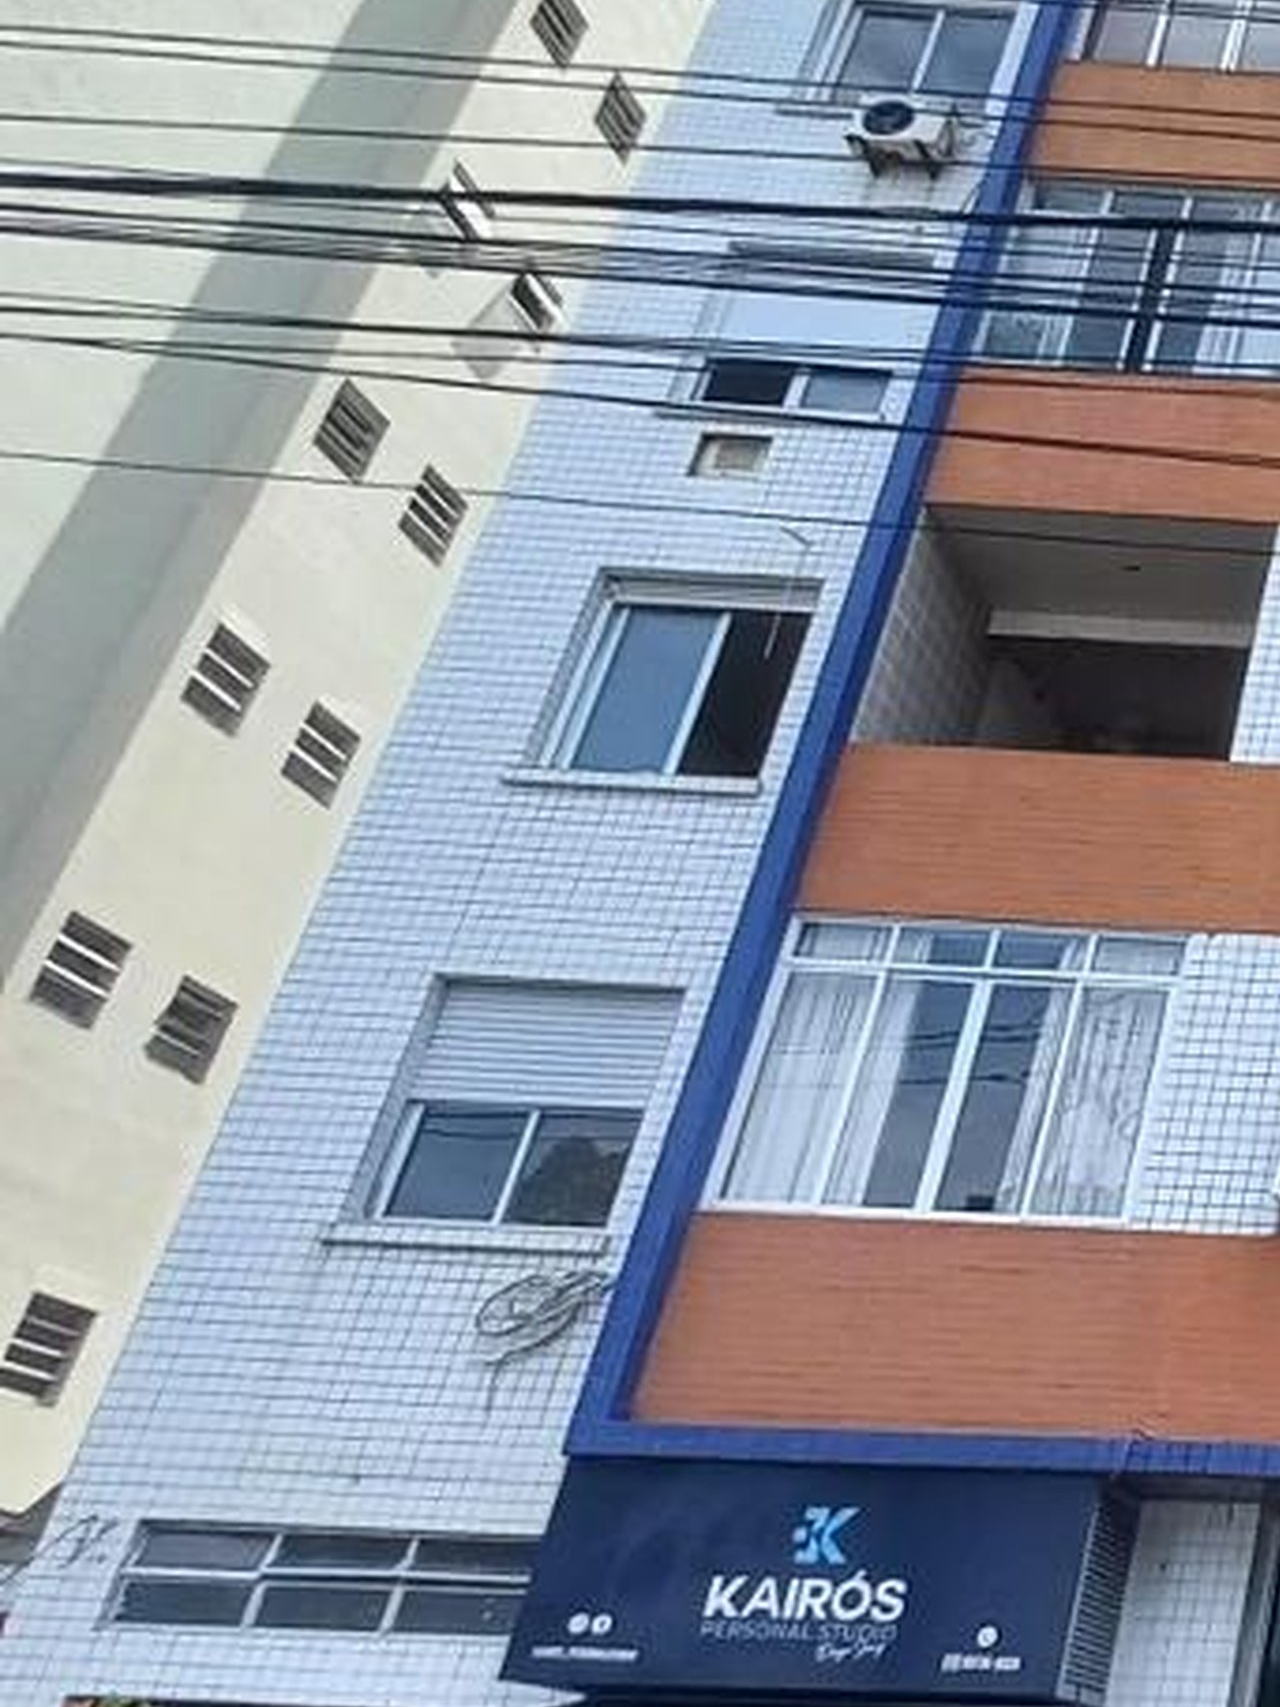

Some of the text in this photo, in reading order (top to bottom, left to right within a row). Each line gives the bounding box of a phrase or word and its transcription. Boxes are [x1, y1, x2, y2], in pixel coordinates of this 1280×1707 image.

[703, 1569, 907, 1624] KAIRÓS
[700, 1621, 898, 1643] PERSONAL STUDIO
